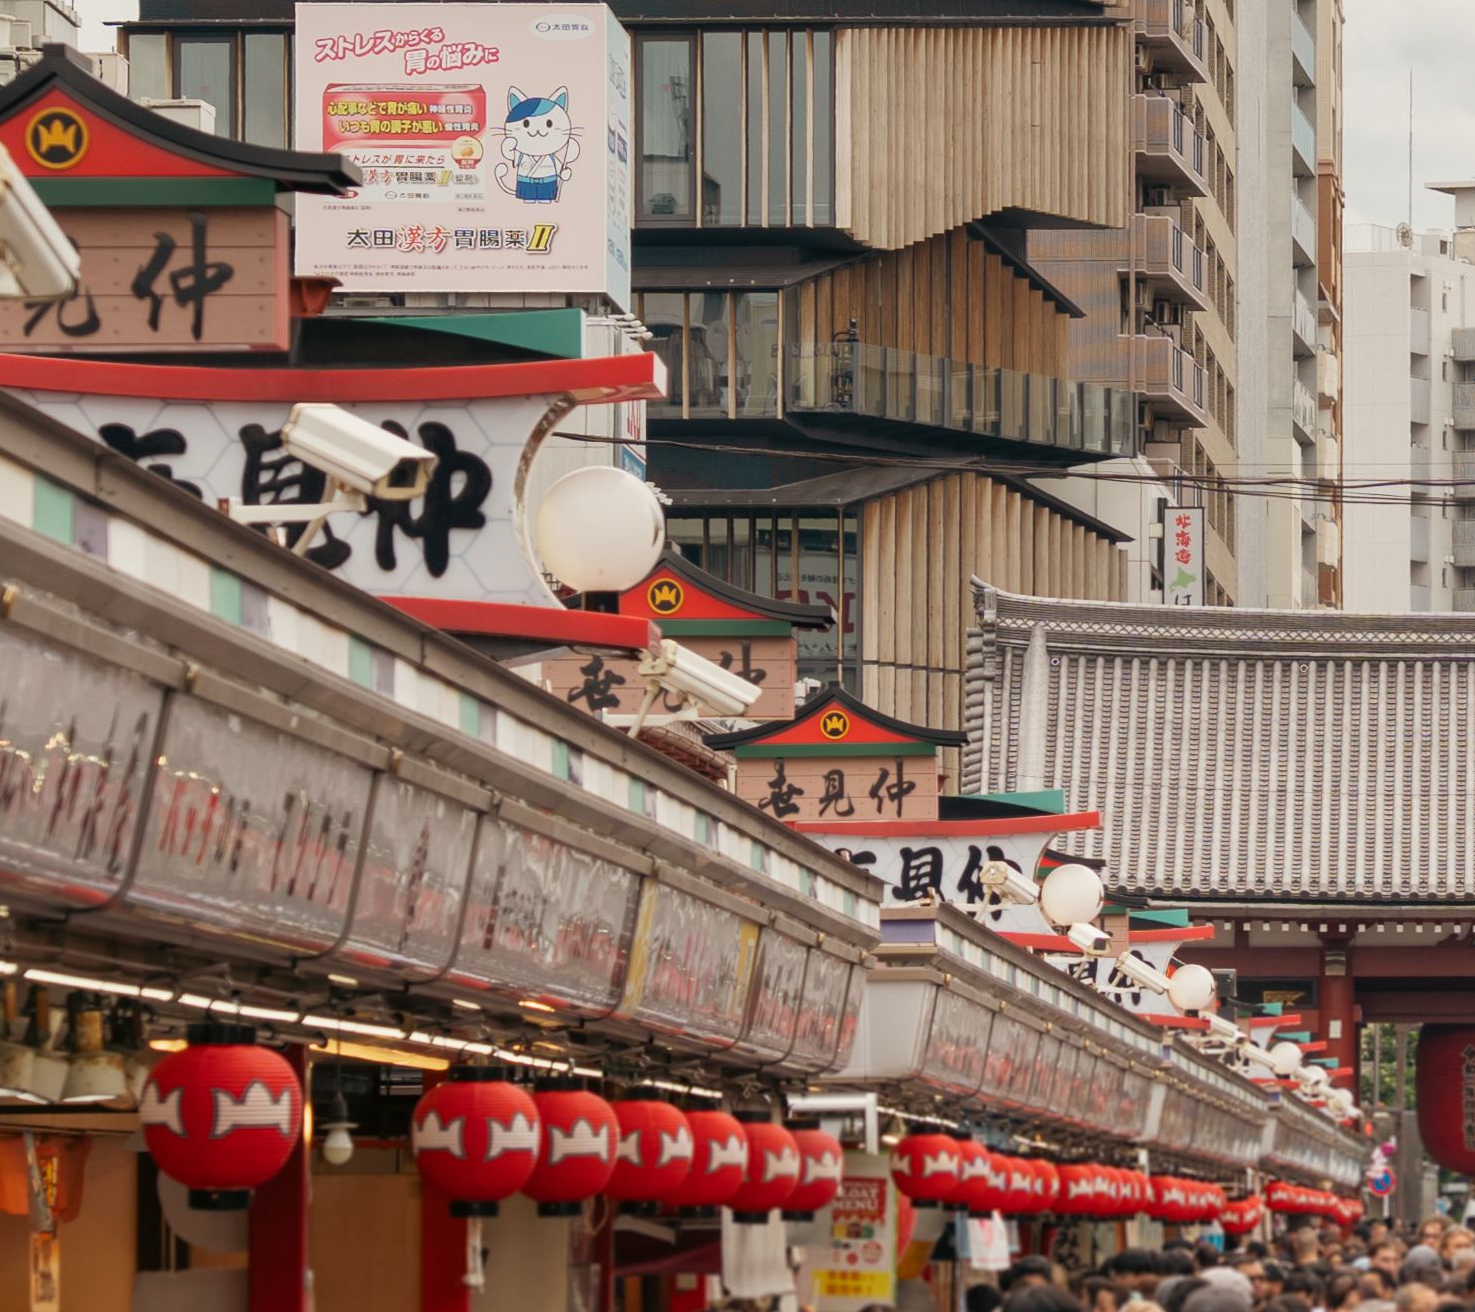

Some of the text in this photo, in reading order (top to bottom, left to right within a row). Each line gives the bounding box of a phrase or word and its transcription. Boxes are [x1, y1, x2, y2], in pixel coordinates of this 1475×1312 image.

[314, 26, 445, 63] ストレスからくる
[403, 41, 500, 76] 胃の悩みに
[345, 154, 446, 166] トレスが胃に来たら
